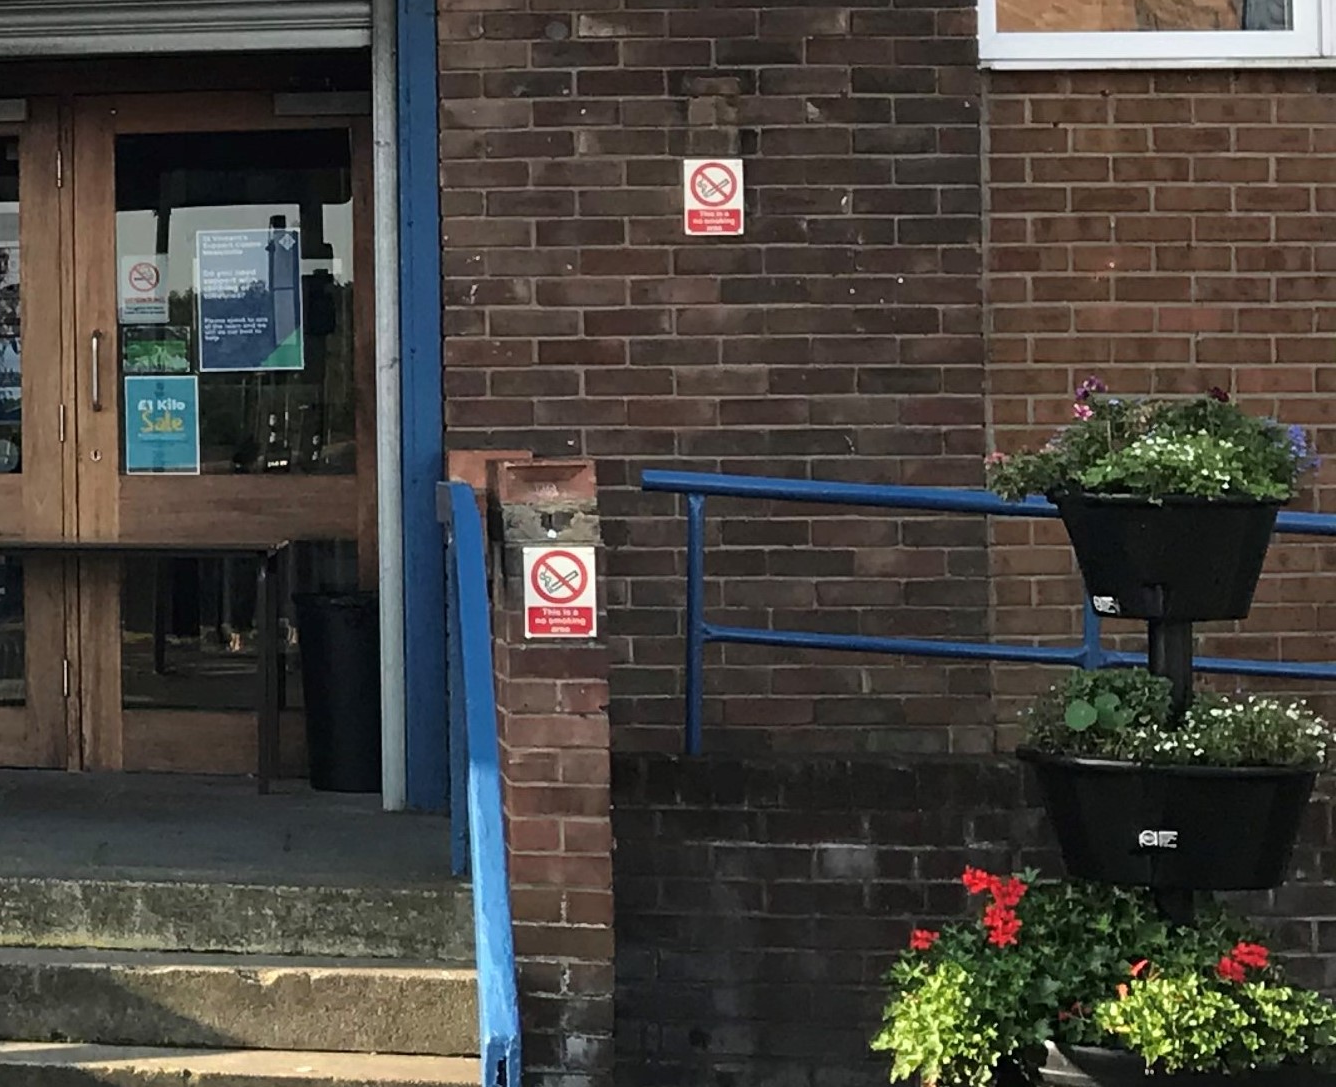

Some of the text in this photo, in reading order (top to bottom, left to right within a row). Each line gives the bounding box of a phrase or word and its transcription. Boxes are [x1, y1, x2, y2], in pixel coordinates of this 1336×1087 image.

[138, 398, 186, 412] £1 Kilo
[140, 410, 185, 432] Sale
[548, 617, 586, 626] smoking
